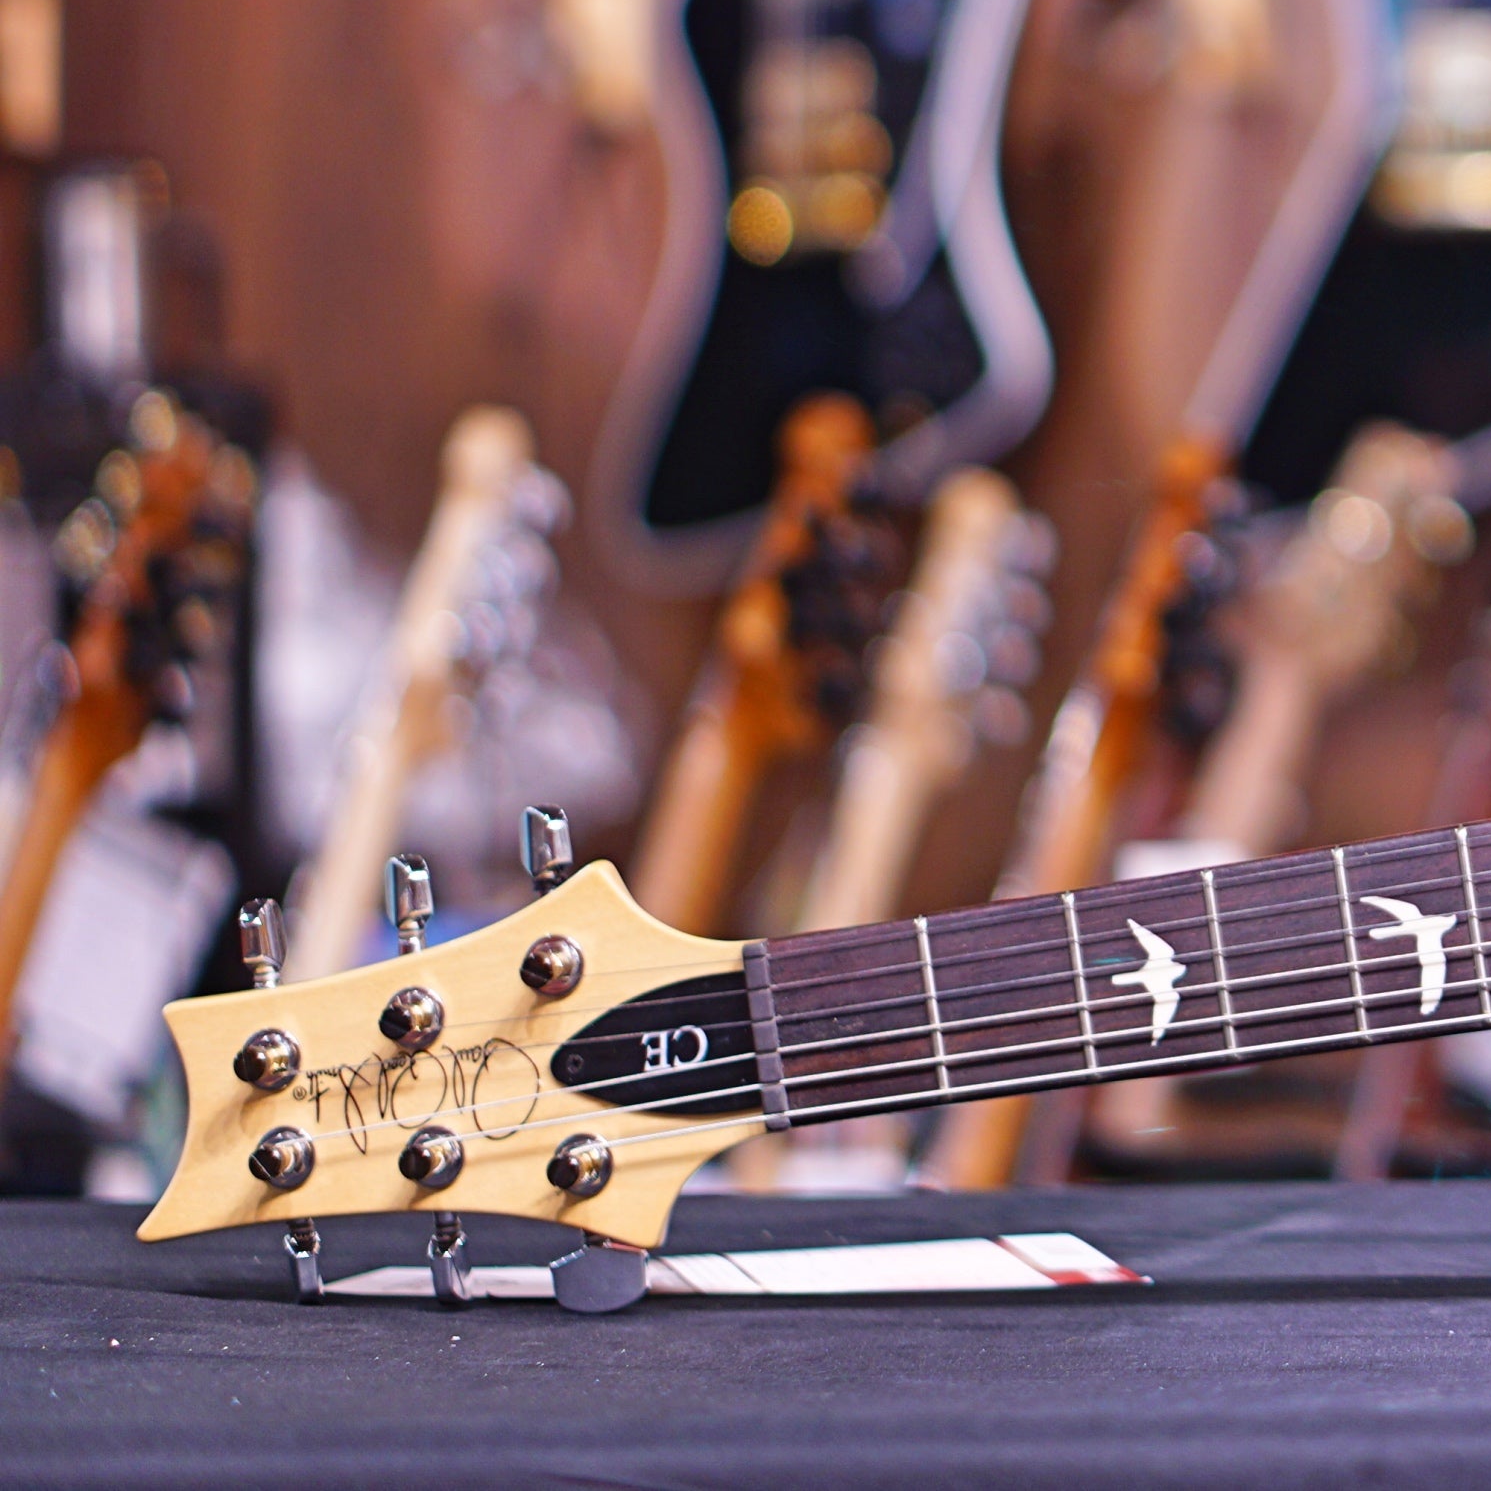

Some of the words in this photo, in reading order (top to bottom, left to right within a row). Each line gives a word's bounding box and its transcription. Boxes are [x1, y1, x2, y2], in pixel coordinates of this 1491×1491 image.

[372, 1048, 447, 1130] Reed
[441, 1036, 540, 1141] Paul
[641, 1024, 709, 1072] CE
